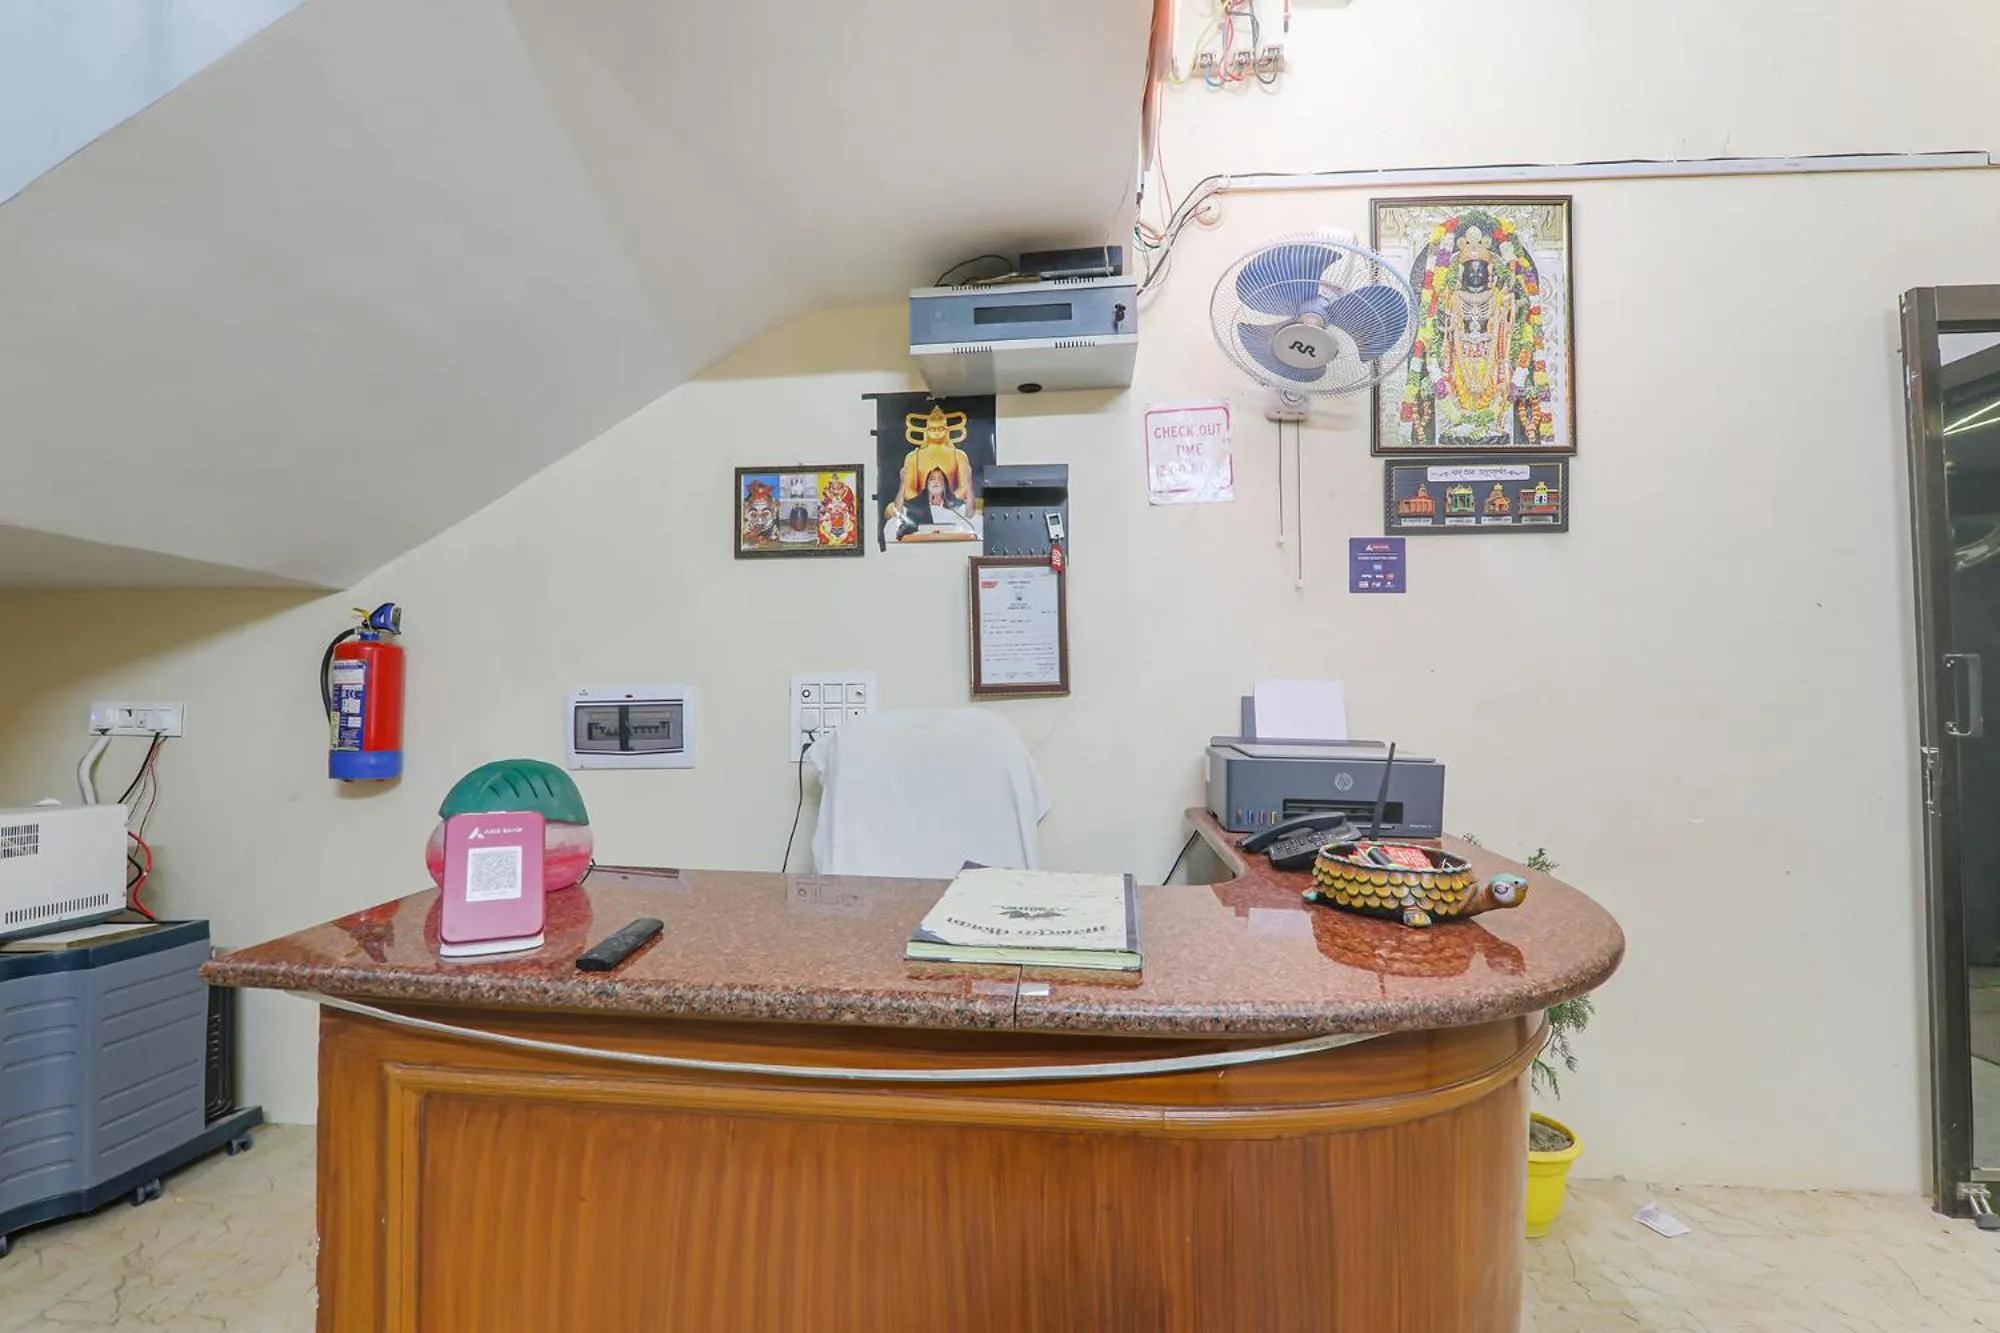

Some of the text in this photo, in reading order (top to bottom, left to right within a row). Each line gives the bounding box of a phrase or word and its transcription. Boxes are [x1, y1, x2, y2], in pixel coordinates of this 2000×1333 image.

[1153, 422, 1222, 439] CHECK OUT
[1175, 443, 1203, 457] TIME
